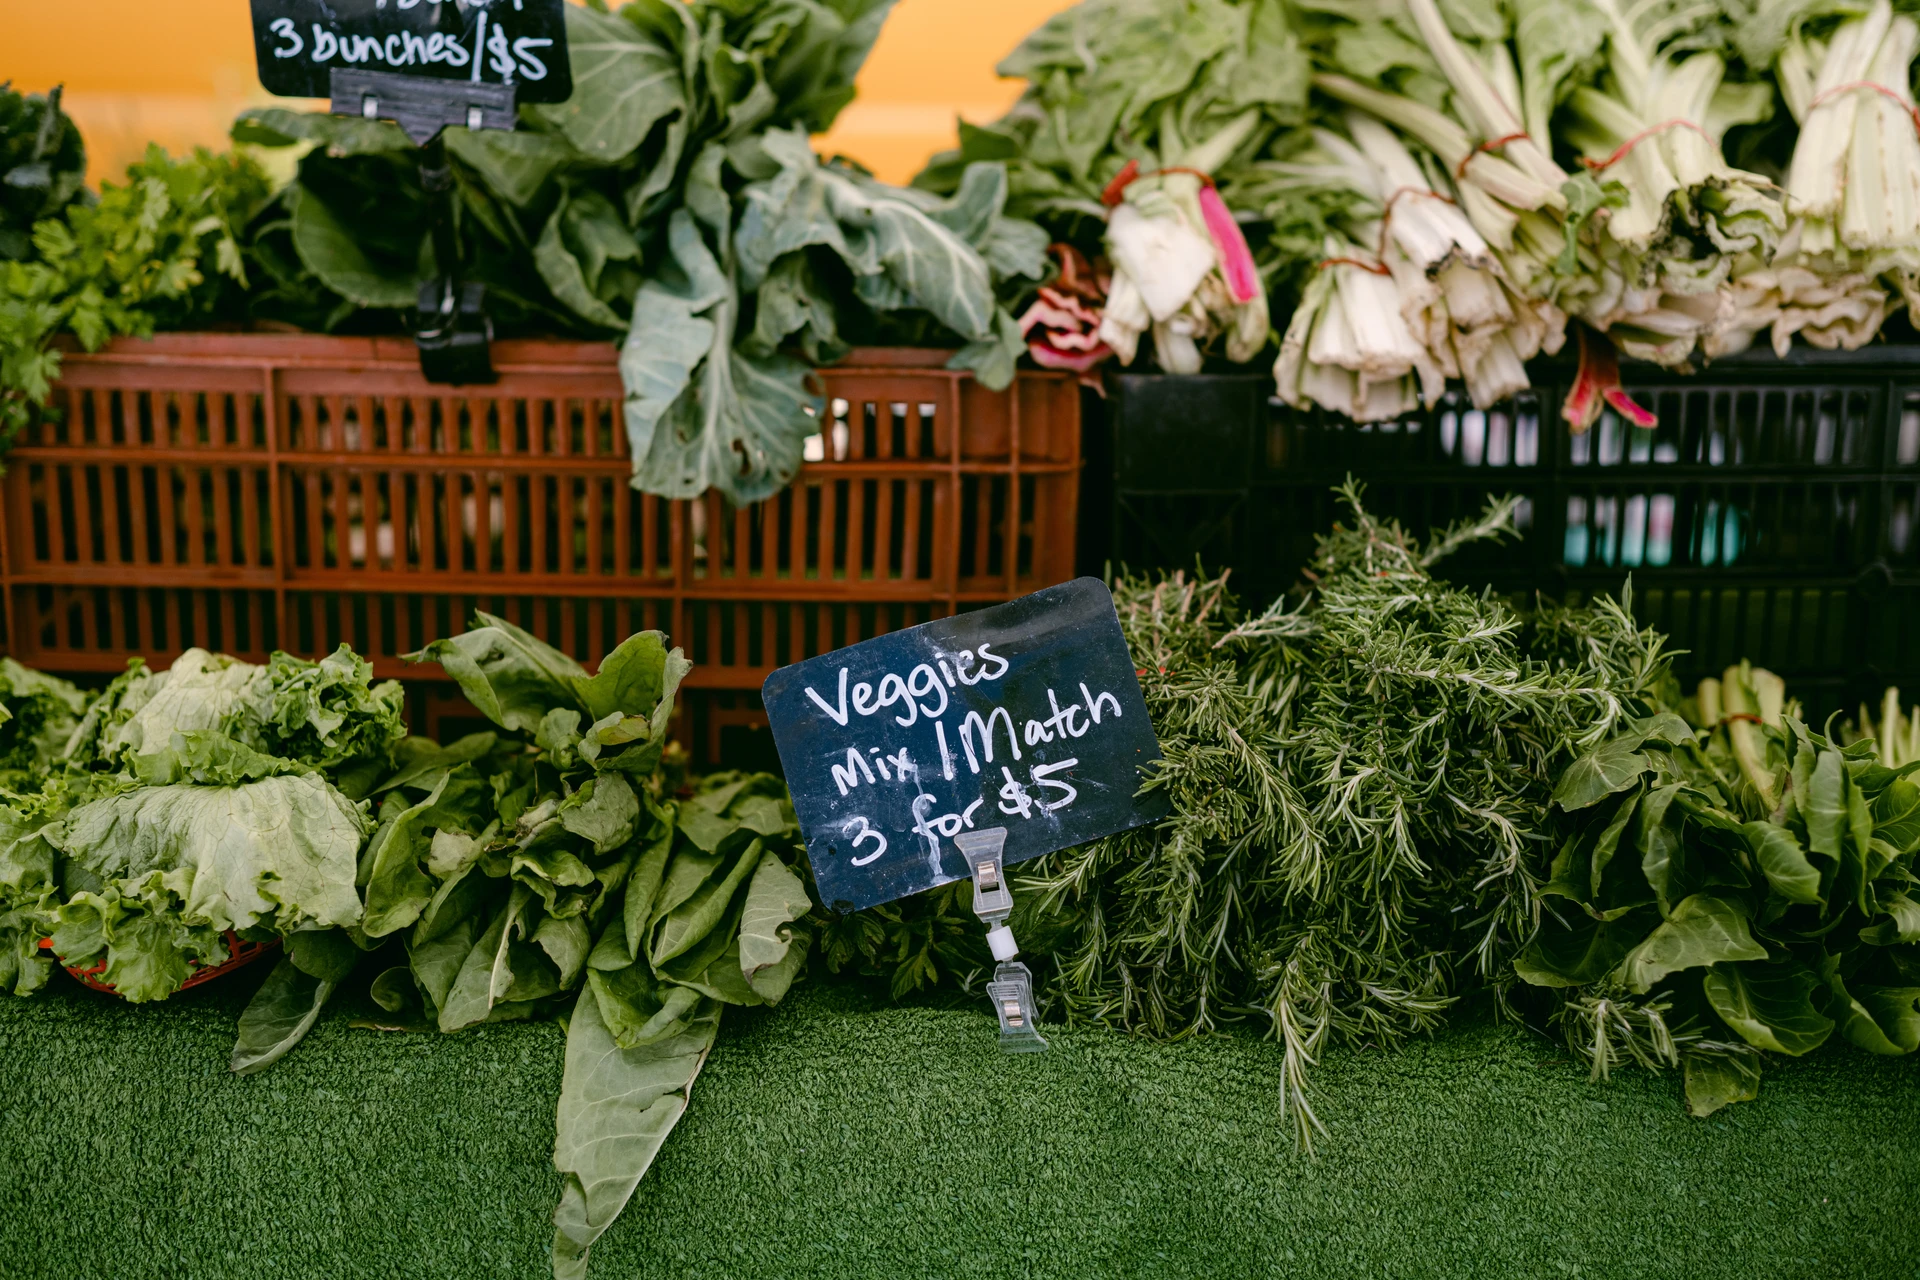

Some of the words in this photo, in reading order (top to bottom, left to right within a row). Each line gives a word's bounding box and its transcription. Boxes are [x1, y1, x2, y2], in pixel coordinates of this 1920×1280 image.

[269, 17, 304, 58] 3
[804, 642, 1009, 727] Veggies
[830, 746, 917, 796] Mix
[842, 815, 888, 867] 3
[911, 793, 984, 852] for
[998, 757, 1079, 820] $5
